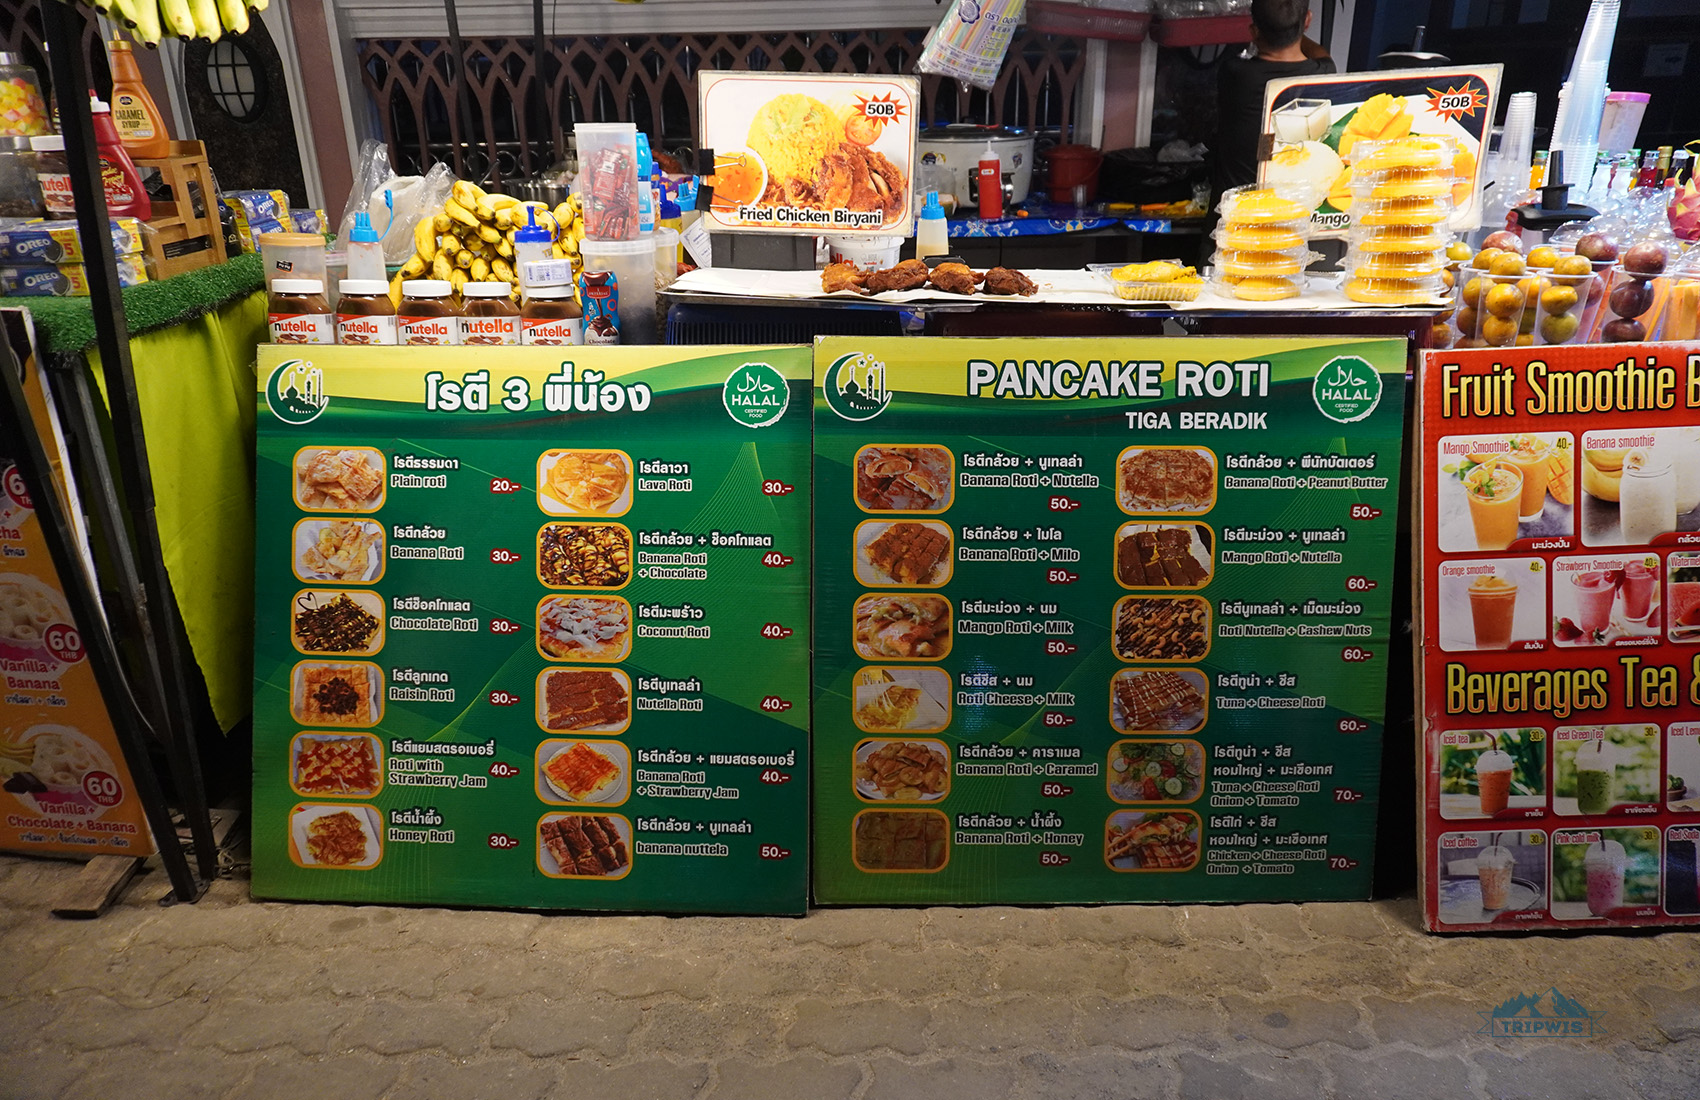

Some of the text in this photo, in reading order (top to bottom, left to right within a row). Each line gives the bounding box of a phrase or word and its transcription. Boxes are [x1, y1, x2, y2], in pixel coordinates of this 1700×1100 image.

[1440, 95, 1471, 110] 50B
[115, 109, 145, 120] CARAMEL
[866, 103, 895, 116] 50B
[121, 120, 141, 129] SYRUP
[257, 199, 275, 214] OREO
[739, 206, 883, 226] Fried Chicken Biryani
[16, 238, 51, 254] OREO
[64, 242, 74, 256] 5
[24, 271, 59, 287] OREO
[71, 276, 81, 290] 5
[274, 320, 316, 333] nutella
[340, 321, 378, 334] nutella
[405, 323, 448, 335] nutella
[461, 318, 514, 334] nutella
[529, 325, 572, 338] nutella
[736, 371, 775, 393] حلال
[968, 361, 1270, 397] PANCAKE ROTI
[426, 362, 651, 412] โรตี 3 พี่น้อง
[1443, 357, 1676, 417] Fruit Smoothie
[731, 393, 780, 407] HALAL
[1321, 388, 1371, 401] HALAL
[1125, 411, 1268, 430] TIGA BERADIK
[1443, 439, 1509, 455] Mango Smoothie
[1556, 438, 1572, 449] 40.-
[1586, 434, 1655, 450] Banana smoothie
[391, 474, 446, 488] Plain roti
[492, 480, 519, 492] 20.-
[638, 478, 692, 491] Lava Roti
[960, 473, 1099, 488] Banana Roti Nutella
[1224, 475, 1388, 489] Banana Roti Peanut Butter
[764, 482, 792, 494] 30.-
[1050, 498, 1079, 509] 50.-
[1352, 506, 1380, 518] 50.-
[390, 545, 464, 560] Banana Roti
[492, 550, 519, 562] 30.-
[638, 552, 707, 565] Banana Roti
[959, 547, 1080, 561] Banana Roti Milo
[764, 554, 791, 565] 40.-
[1556, 559, 1623, 572] Strawberry Smoothie
[1644, 557, 1658, 567] 40.-
[649, 566, 708, 579] Chocolate
[1442, 563, 1495, 576] Orange smoothie
[1530, 562, 1544, 571] 40.-
[390, 616, 478, 632] Chocolate Roti
[491, 621, 519, 632] 30.-
[958, 620, 1074, 635] Mango Roti Milk
[1219, 624, 1372, 637] Roti Nutella Cashew Nuts
[637, 624, 711, 639] Coconut Roti
[763, 625, 790, 637] 40.-
[49, 631, 81, 652] 60
[1047, 642, 1075, 653] 50.-
[59, 651, 78, 660] THB
[1343, 649, 1371, 660] 60.-
[0, 659, 48, 673] Vanilla
[7, 676, 60, 691] Banana
[1446, 656, 1678, 718] Beverages Tea
[389, 687, 455, 702] Raisin Roti
[491, 692, 518, 704] 30.-
[957, 692, 1075, 705] Roti Cheese Milk
[637, 697, 703, 711] Nutella Roti
[762, 698, 790, 710] 40.-
[1045, 714, 1073, 725] 50.-
[1530, 731, 1544, 741] 30.-
[1556, 728, 1604, 740] Iced Green Tea
[1644, 727, 1658, 737] 30.-
[1443, 735, 1469, 745] Iced tea
[389, 758, 444, 773] Roti with
[490, 764, 518, 776] 40.-
[86, 777, 117, 795] 60
[389, 773, 487, 788] Strawberry Jam
[1212, 781, 1320, 793] Tuna Cheese Roti
[97, 795, 114, 804] THB
[1211, 795, 1300, 807] Onion Tomato
[1335, 790, 1362, 801] 70.-
[39, 801, 88, 816] Vanilla
[7, 815, 137, 834] Chocolate Banana
[388, 829, 455, 844] Honey Roti
[490, 836, 517, 847] 30.-
[1442, 836, 1478, 848] Iced coffee
[1556, 832, 1600, 843] Pink cold milk
[636, 842, 729, 856] banana nuttela
[761, 846, 789, 858] 50.-
